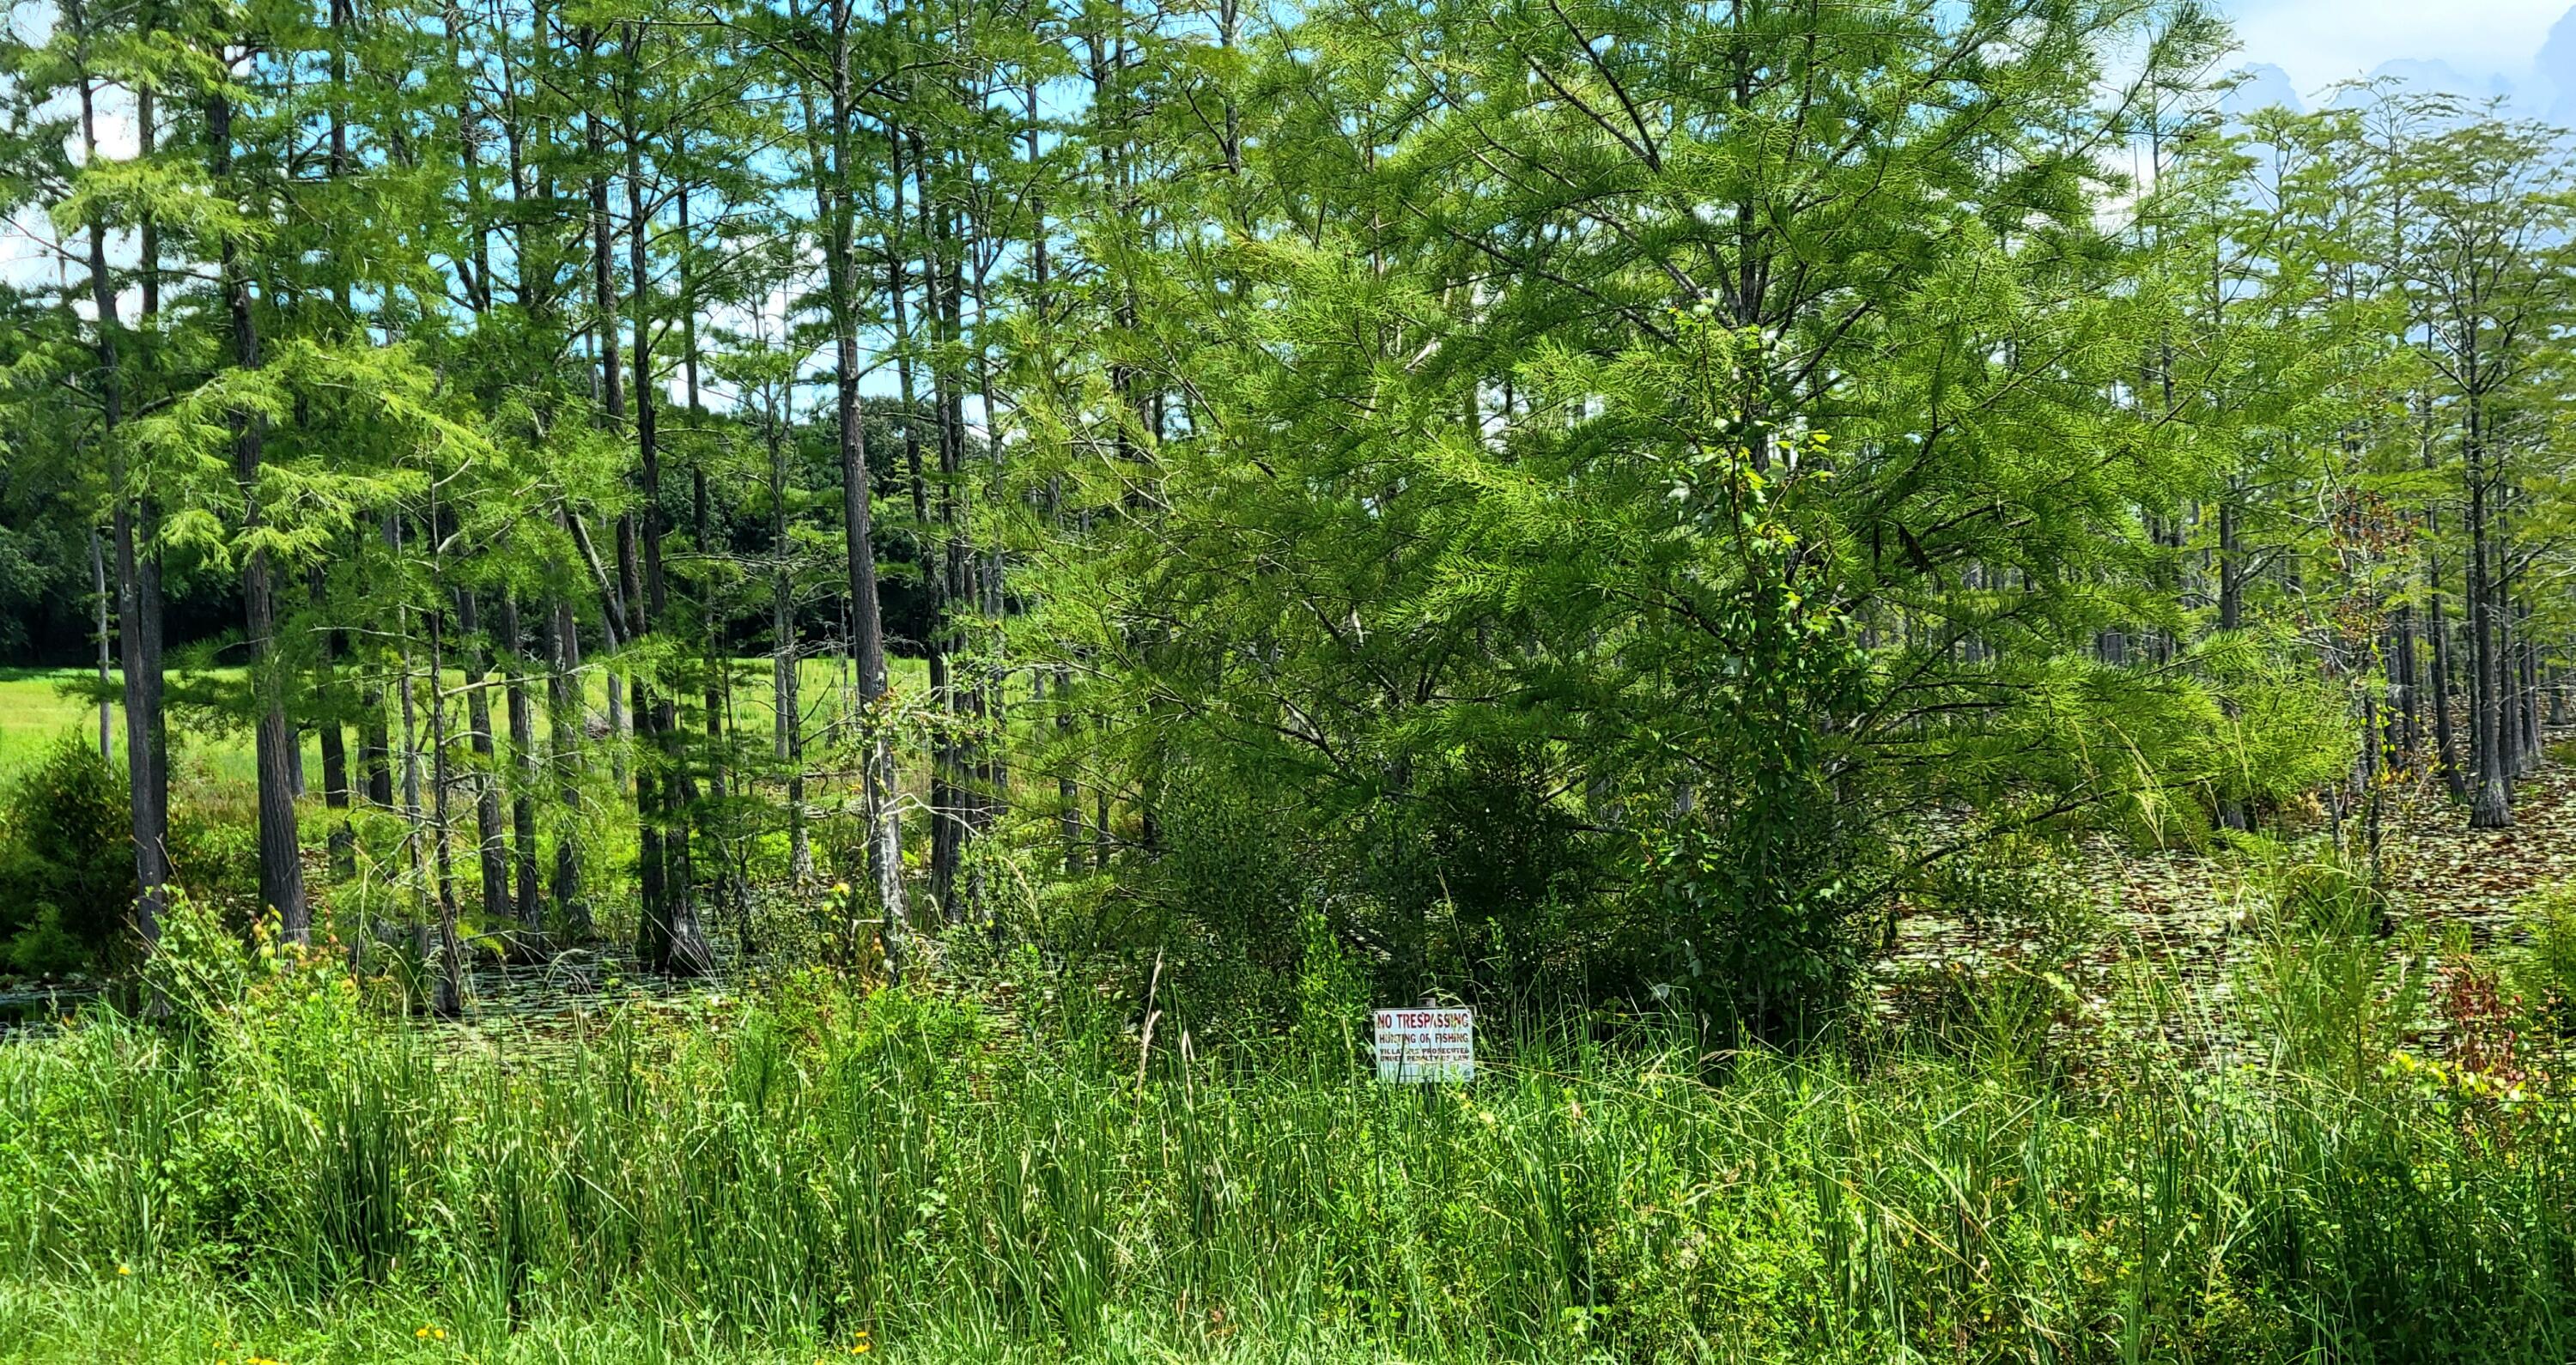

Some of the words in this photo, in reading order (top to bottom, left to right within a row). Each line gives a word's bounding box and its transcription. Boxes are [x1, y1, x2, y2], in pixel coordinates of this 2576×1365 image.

[1377, 1013, 1392, 1028] NO
[1396, 1012, 1469, 1028] TRESPASSING
[1435, 1033, 1468, 1043] FISHING
